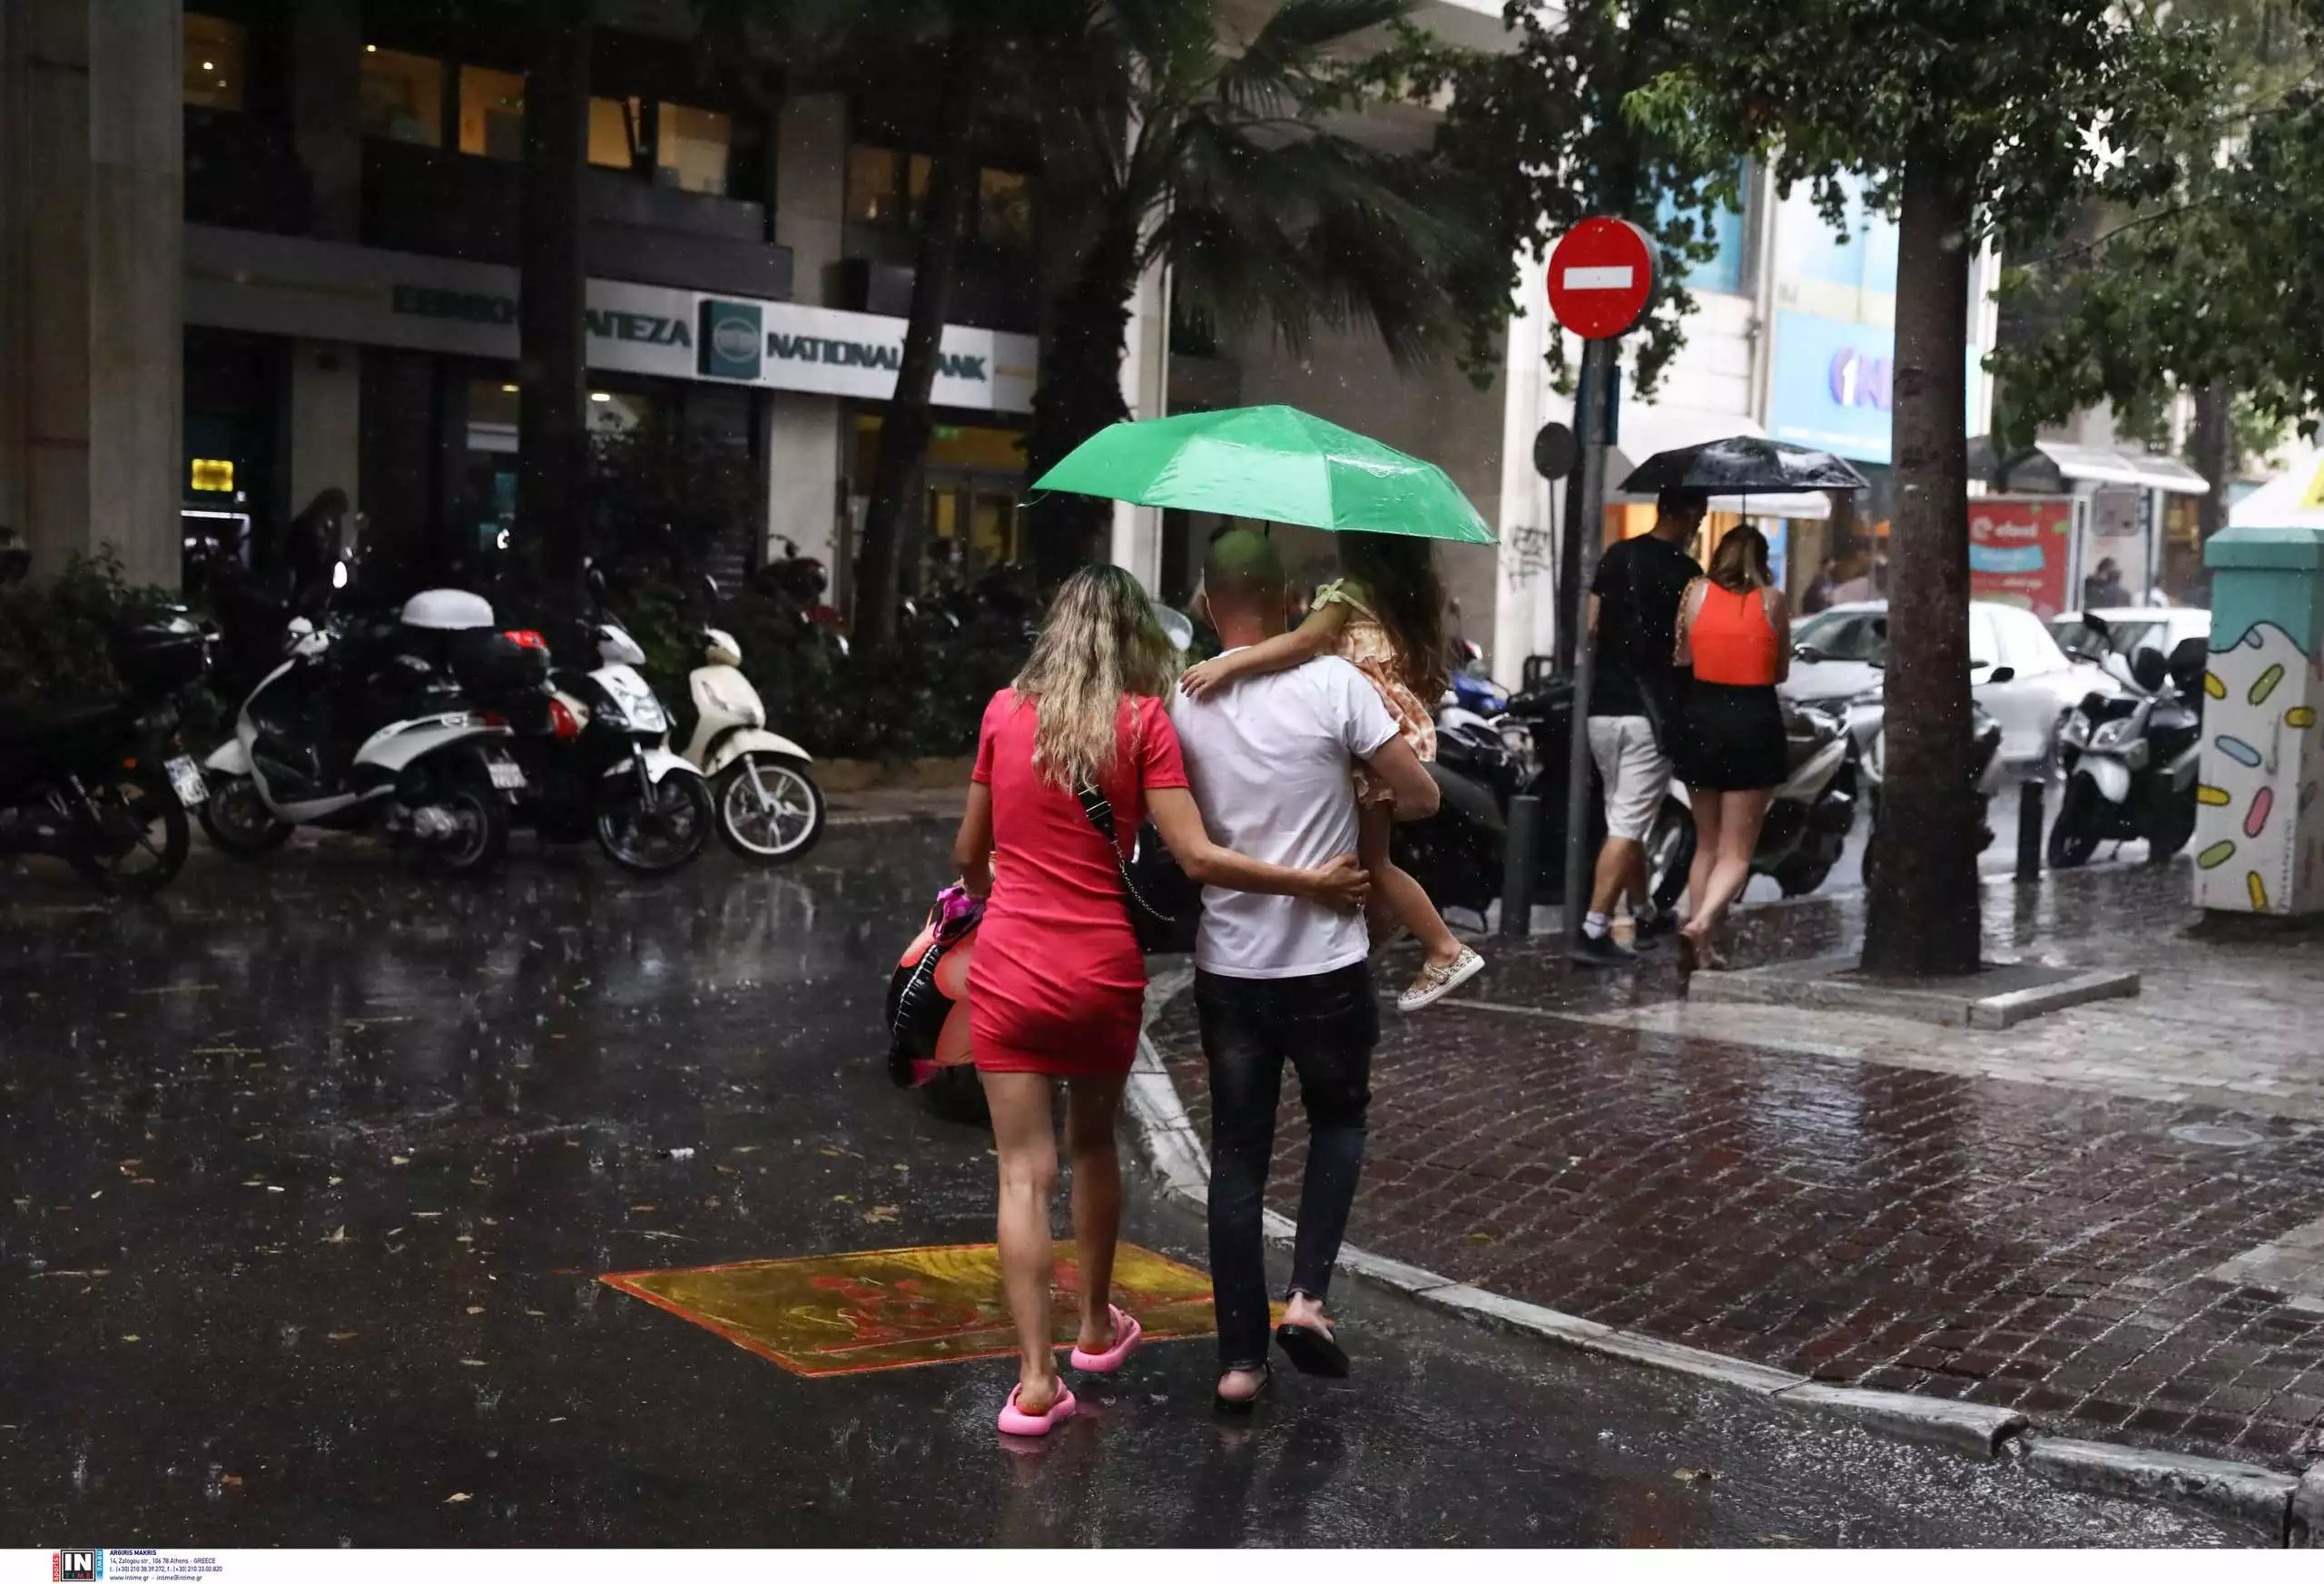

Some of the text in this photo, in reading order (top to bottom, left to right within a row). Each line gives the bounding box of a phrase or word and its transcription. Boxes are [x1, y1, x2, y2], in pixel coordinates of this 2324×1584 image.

[586, 310, 692, 348] ΑΠΕΖΑ
[767, 332, 987, 382] NATIONAL ANK
